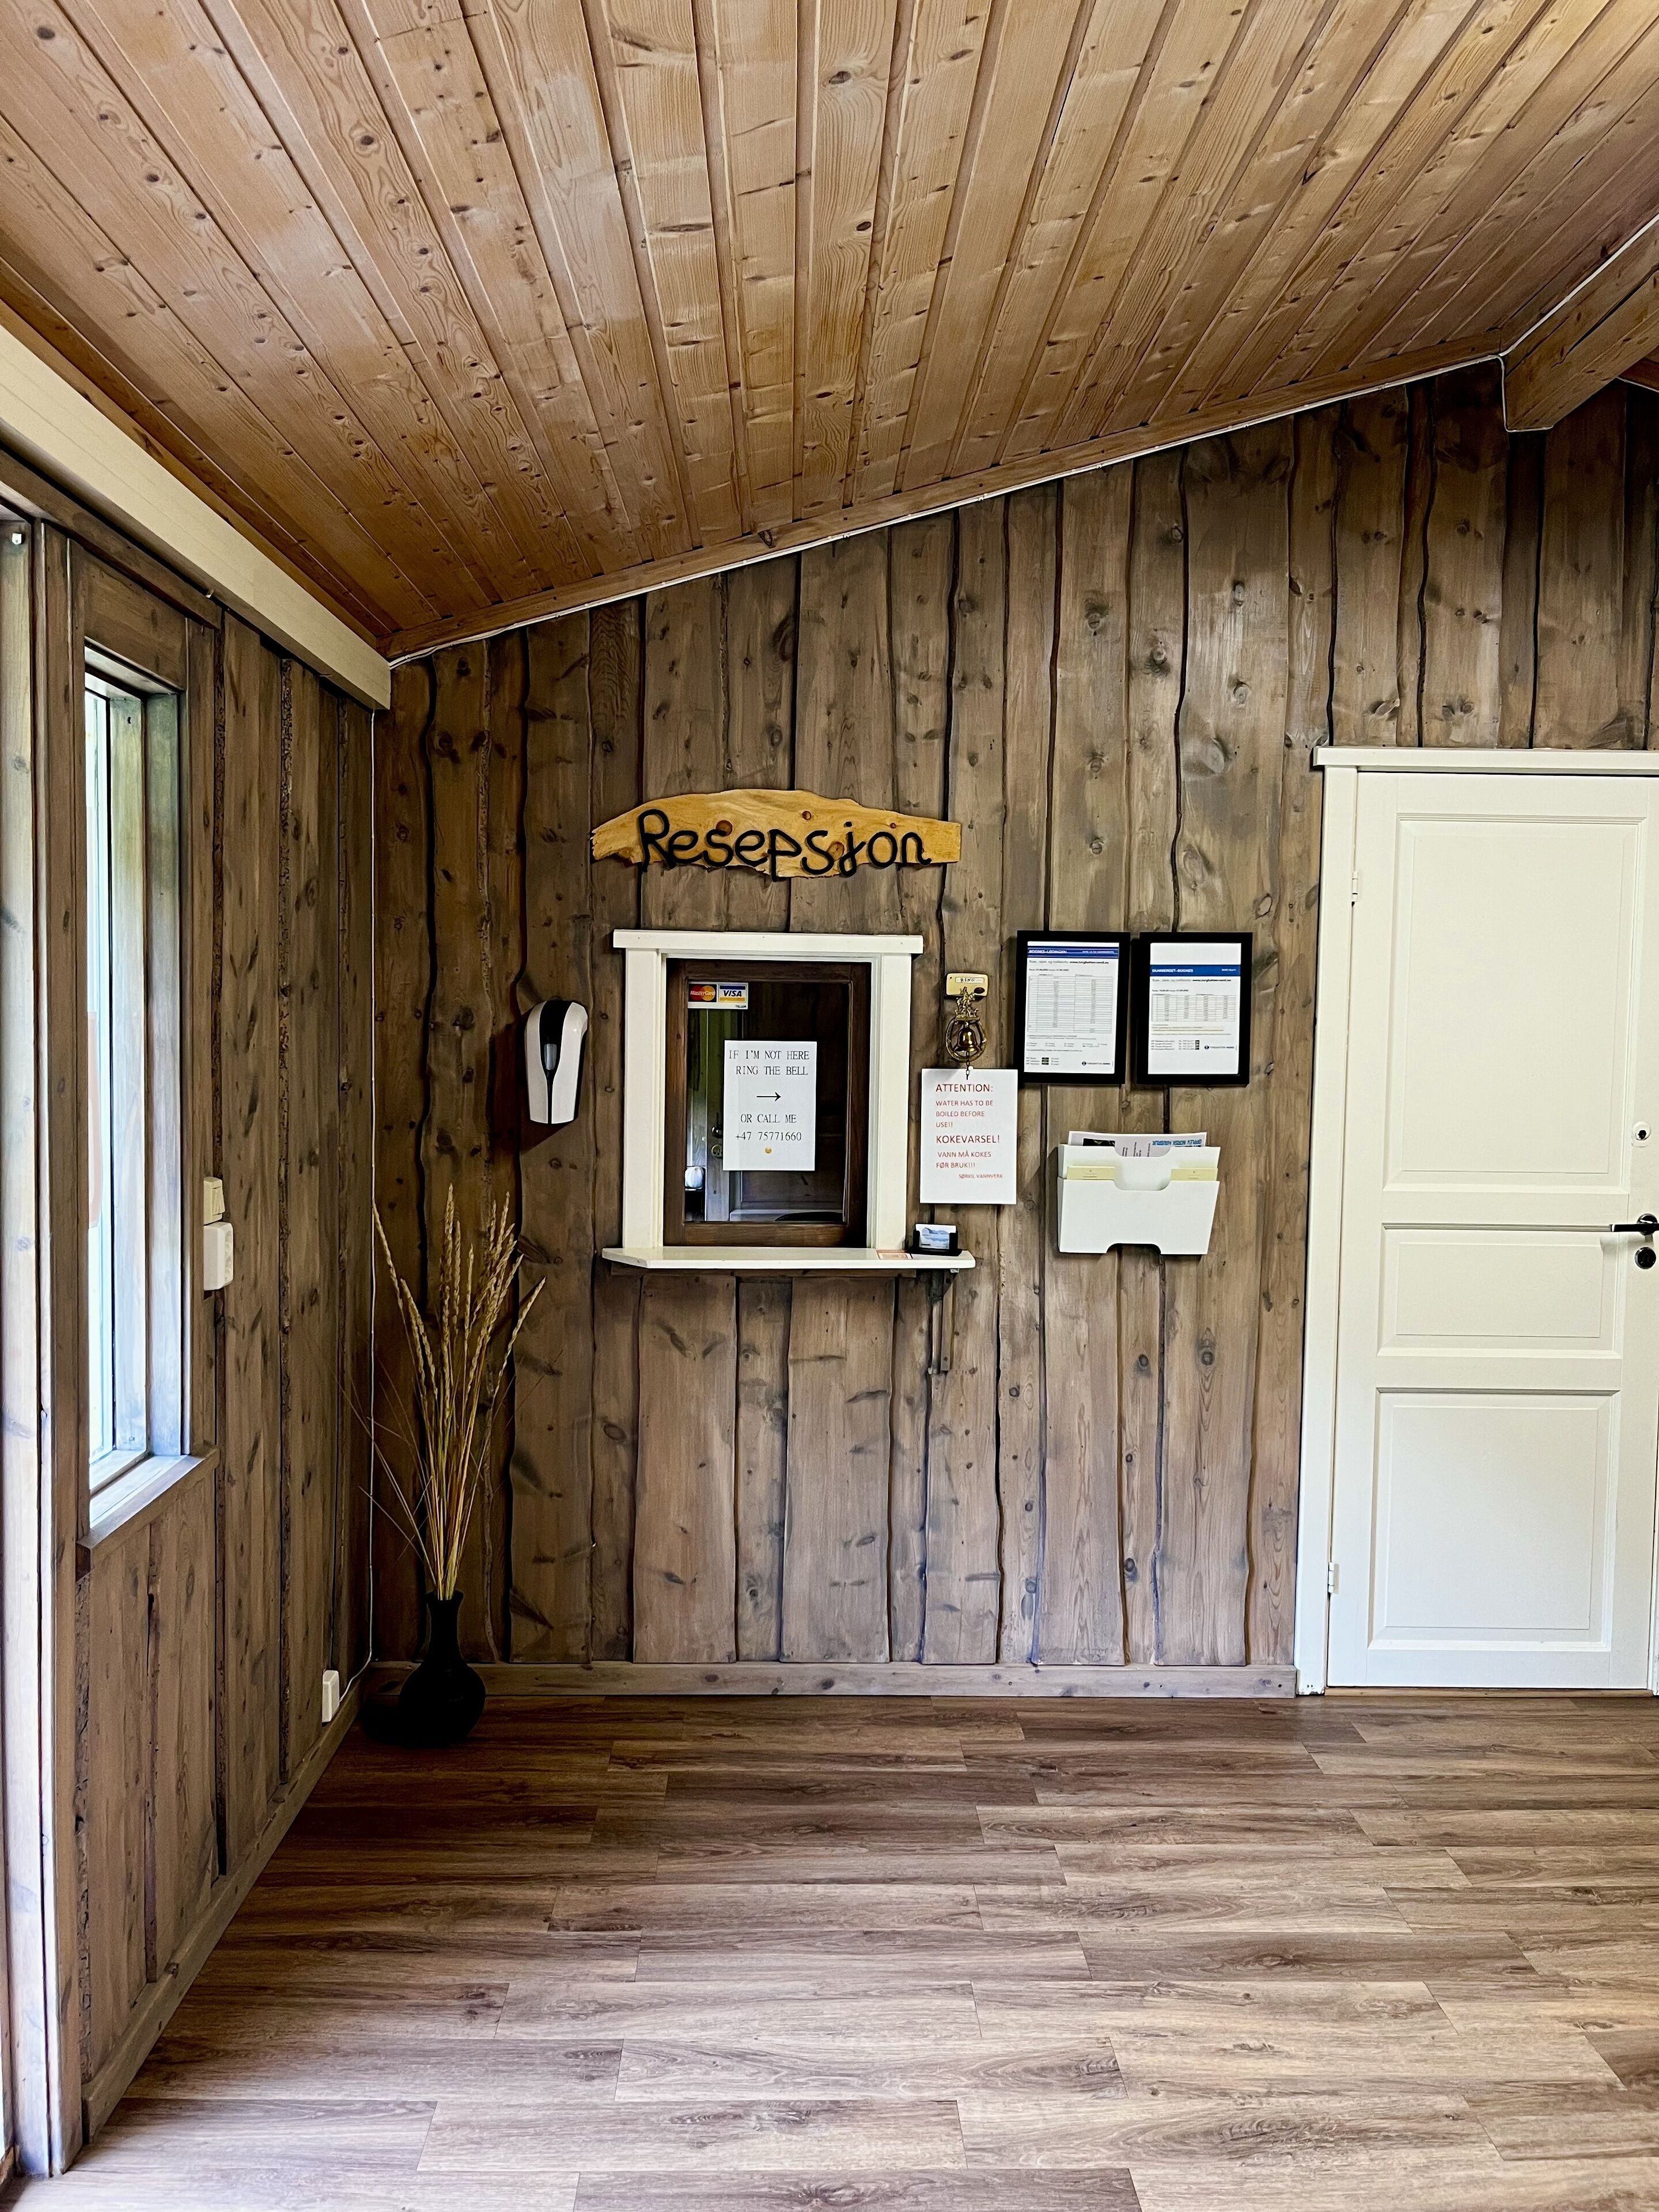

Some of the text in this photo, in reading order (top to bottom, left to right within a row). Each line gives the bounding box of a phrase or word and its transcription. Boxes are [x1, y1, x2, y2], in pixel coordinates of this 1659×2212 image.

[637, 809, 932, 882] Resepsjon
[729, 1050, 740, 1059] IF
[764, 1050, 782, 1059] NOT
[787, 1051, 810, 1060] HERE
[736, 1066, 808, 1075] RING THE BELL
[935, 1084, 993, 1092] ATTENTION:
[740, 1114, 797, 1123] OR CALL ME
[734, 1131, 802, 1141] +47 75771660
[936, 1135, 1000, 1143] KOKEVARSEL!
